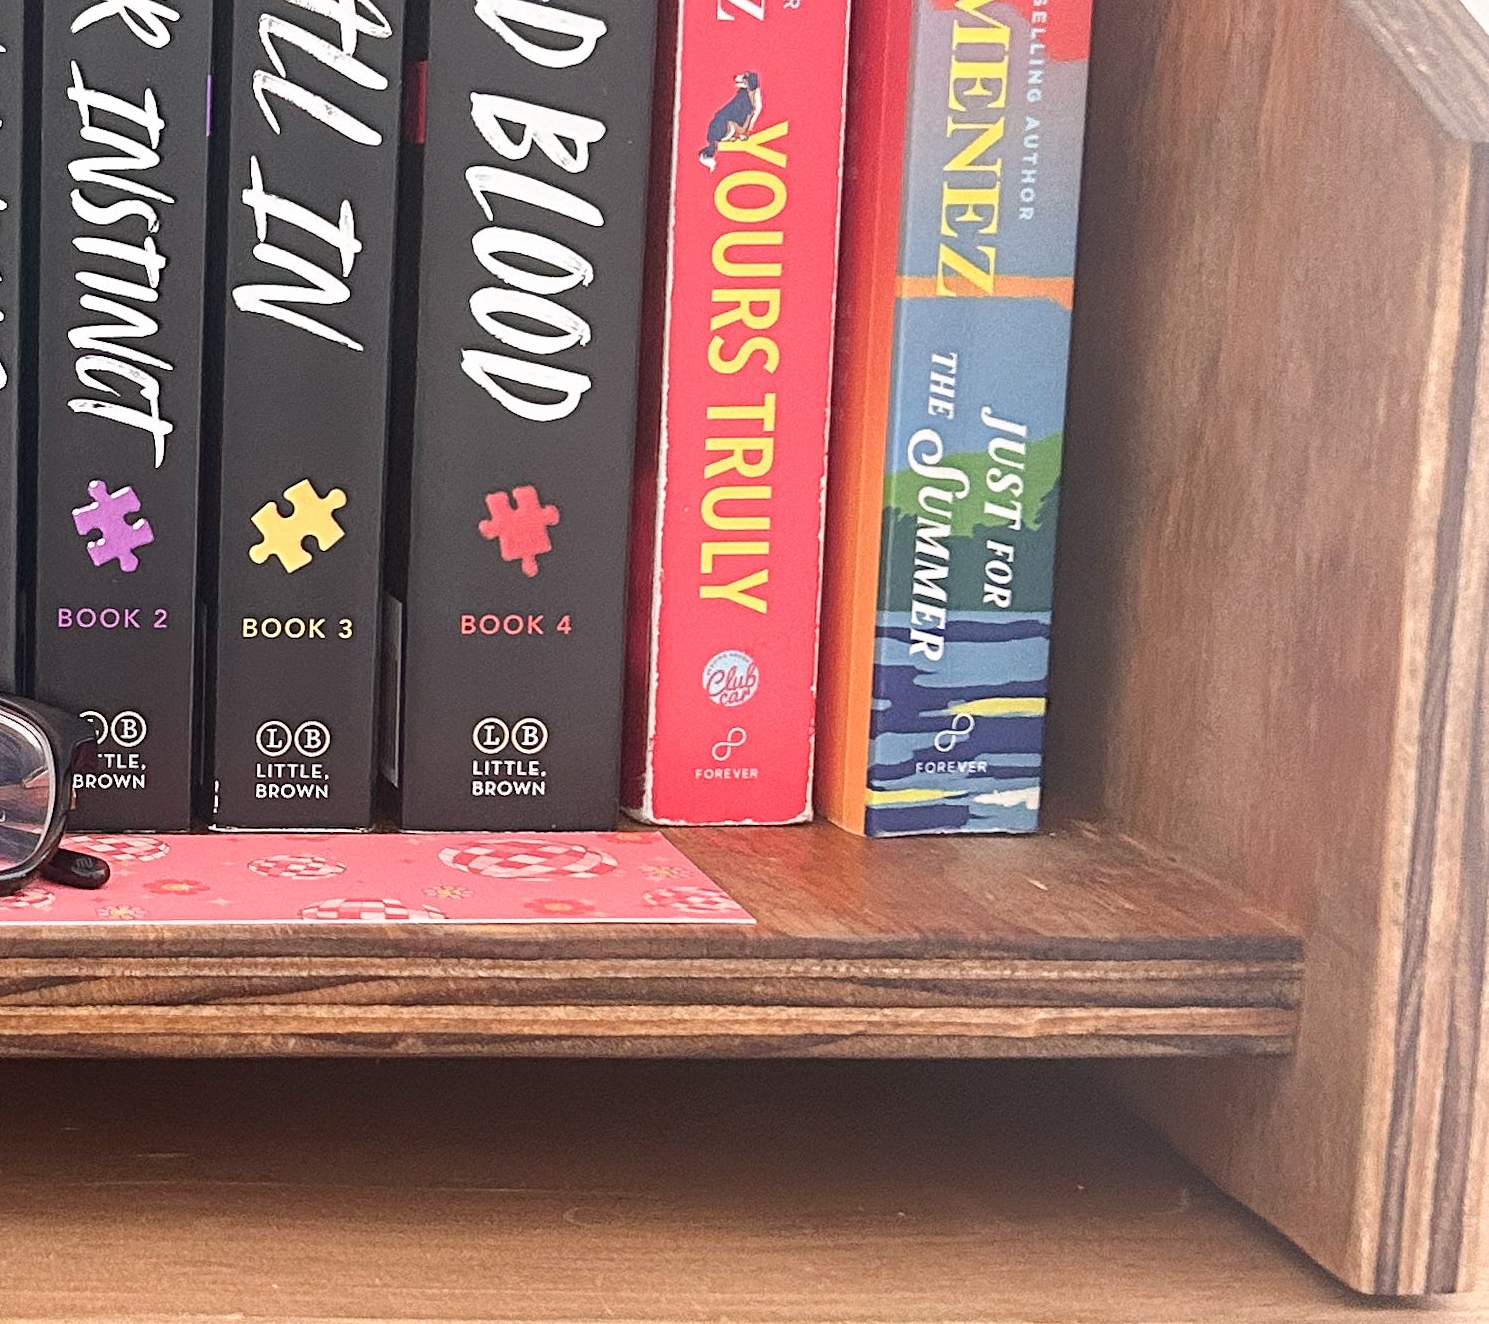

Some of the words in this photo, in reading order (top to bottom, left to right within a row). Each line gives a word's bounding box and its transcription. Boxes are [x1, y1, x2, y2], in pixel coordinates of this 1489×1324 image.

[1018, 116, 1041, 222] AUTHOR
[66, 60, 175, 469] INSTINCT
[232, 156, 364, 352] IN
[461, 92, 607, 422] BLOOD
[707, 120, 789, 375] YOURS
[927, 352, 958, 421] THE
[980, 406, 1027, 532] JUST
[699, 392, 775, 614] TRULY
[907, 428, 970, 663] SUMMER
[983, 541, 1015, 610] FOR
[58, 607, 140, 629] BOOK
[153, 609, 168, 629] 2
[242, 617, 325, 639] BOOK
[339, 618, 353, 639] 3
[460, 614, 544, 636] BOOK
[556, 614, 572, 635] 4
[73, 773, 145, 790] BROWN
[256, 763, 330, 781] LITTLE,
[472, 760, 547, 776] LITTLE,
[472, 781, 546, 796] BROWN
[695, 768, 759, 780] FOREVER
[914, 760, 988, 775] FOREVER
[255, 783, 329, 799] BROWN
